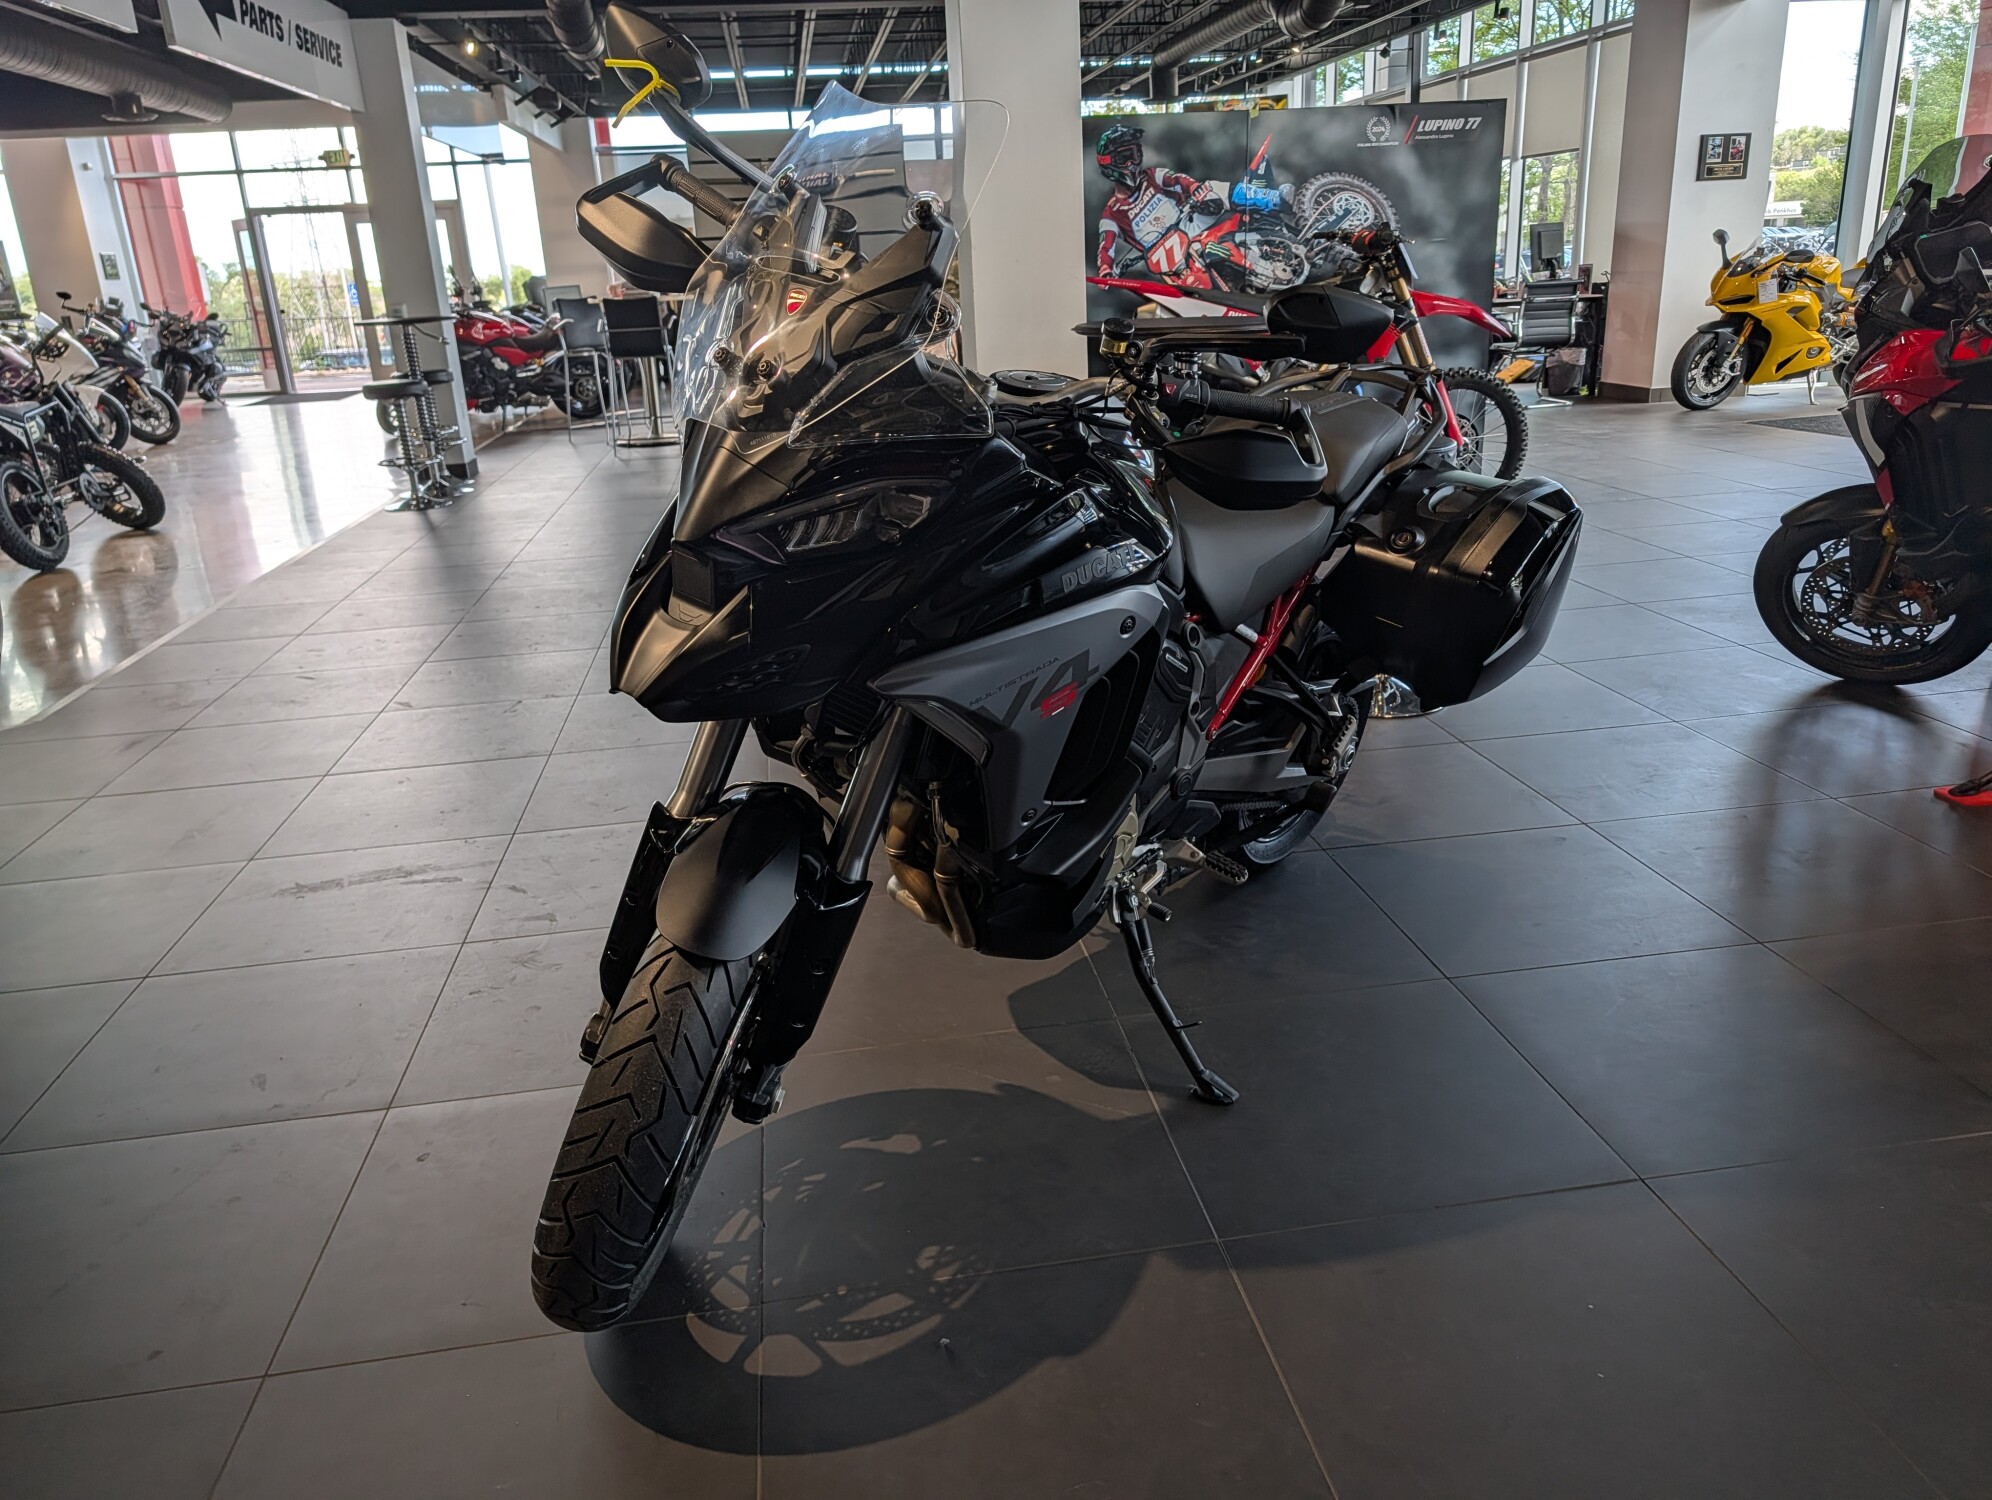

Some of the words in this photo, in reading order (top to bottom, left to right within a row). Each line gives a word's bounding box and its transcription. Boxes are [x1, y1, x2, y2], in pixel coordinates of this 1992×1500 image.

[240, 0, 284, 42] PARTS
[295, 23, 342, 68] SERVICE
[1416, 118, 1465, 132] LUPINO
[1465, 117, 1482, 130] 77
[1127, 187, 1155, 220] DUCATI
[1134, 195, 1163, 229] POLIZIA
[1151, 233, 1182, 273] 77
[1061, 543, 1137, 595] DUCATI
[969, 656, 1060, 707] MULTISTRADA
